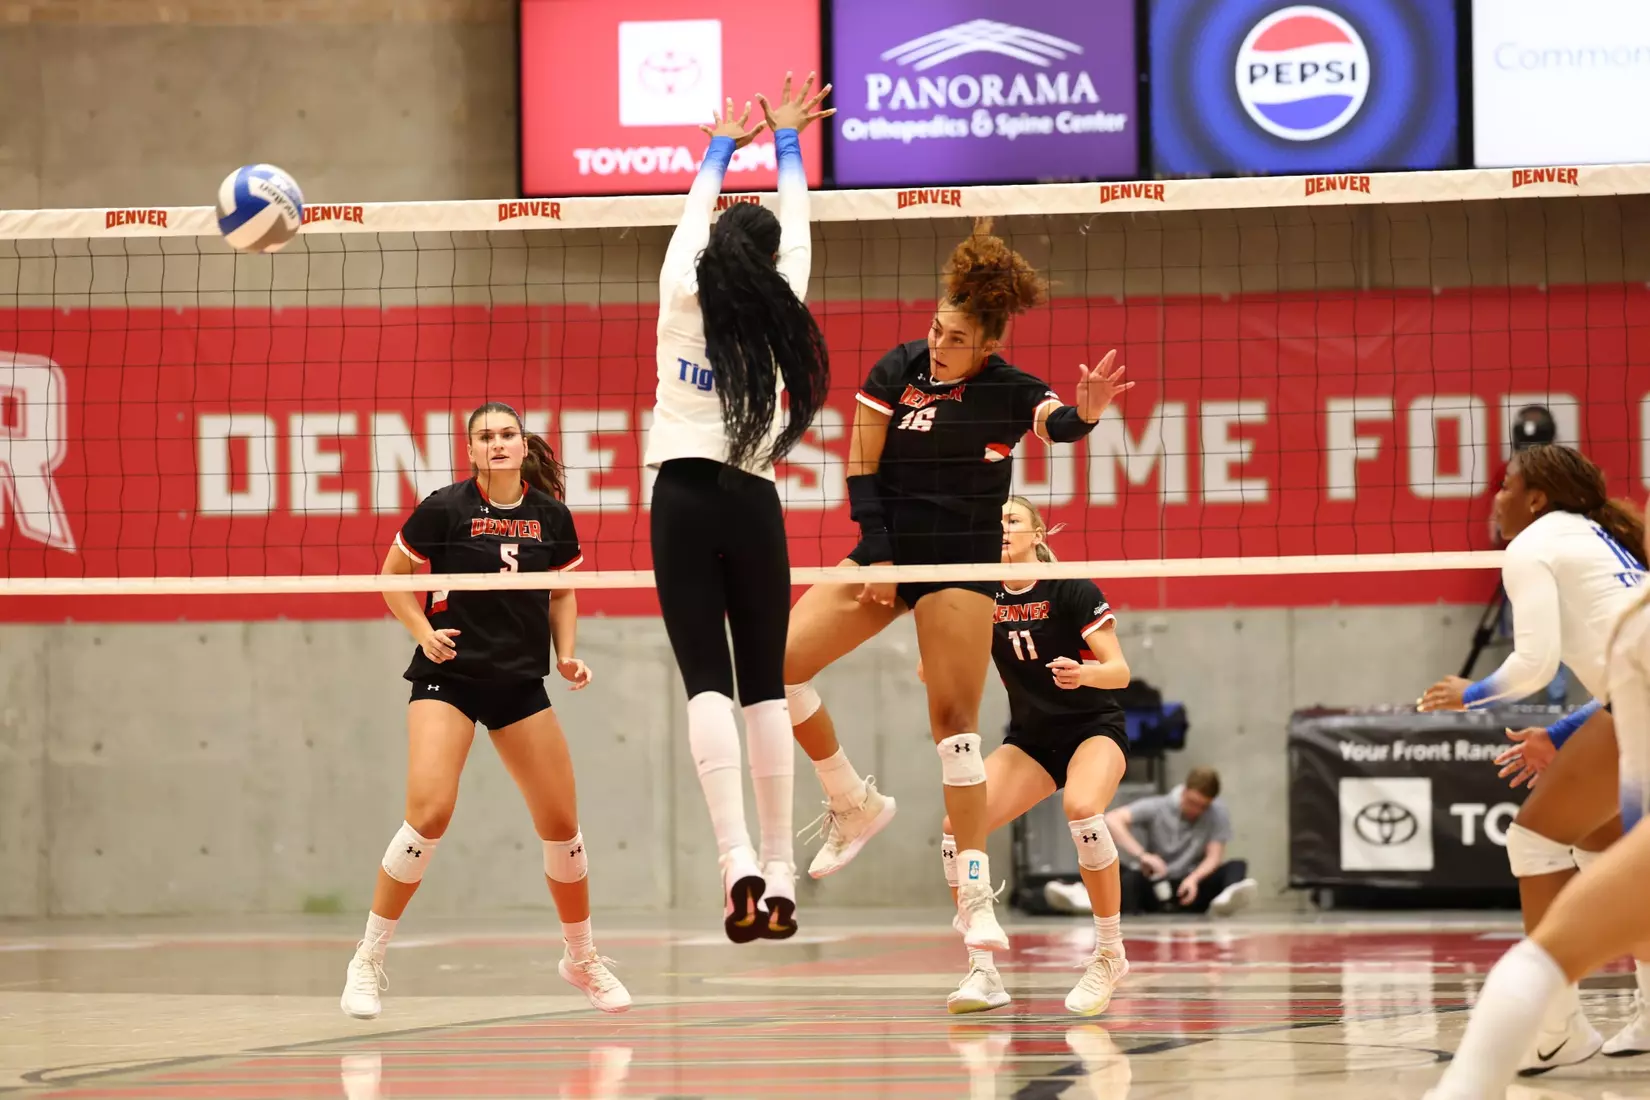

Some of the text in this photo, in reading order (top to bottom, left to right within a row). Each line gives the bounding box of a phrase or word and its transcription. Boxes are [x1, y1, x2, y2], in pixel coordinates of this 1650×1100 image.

[1249, 60, 1357, 85] PEPSI
[865, 71, 1100, 111] PANORAMA
[842, 109, 1128, 143] Orthopedics & Spine Center
[573, 144, 777, 176] TOYOTA.OM
[1305, 175, 1371, 197] DENVER
[1512, 167, 1579, 189] DENVER
[897, 189, 962, 209] DENVER
[1100, 183, 1165, 204] DENVER
[105, 209, 168, 230] DENVER
[301, 205, 364, 225] DENVER
[498, 201, 561, 222] DENVER
[677, 357, 713, 392] Tig
[897, 406, 938, 432] 16
[471, 517, 542, 542] DENVER
[500, 543, 518, 573] 5
[1008, 629, 1038, 661] 11
[1339, 739, 1390, 761] Your
[1392, 739, 1452, 761] Front
[1450, 802, 1520, 846] TO
